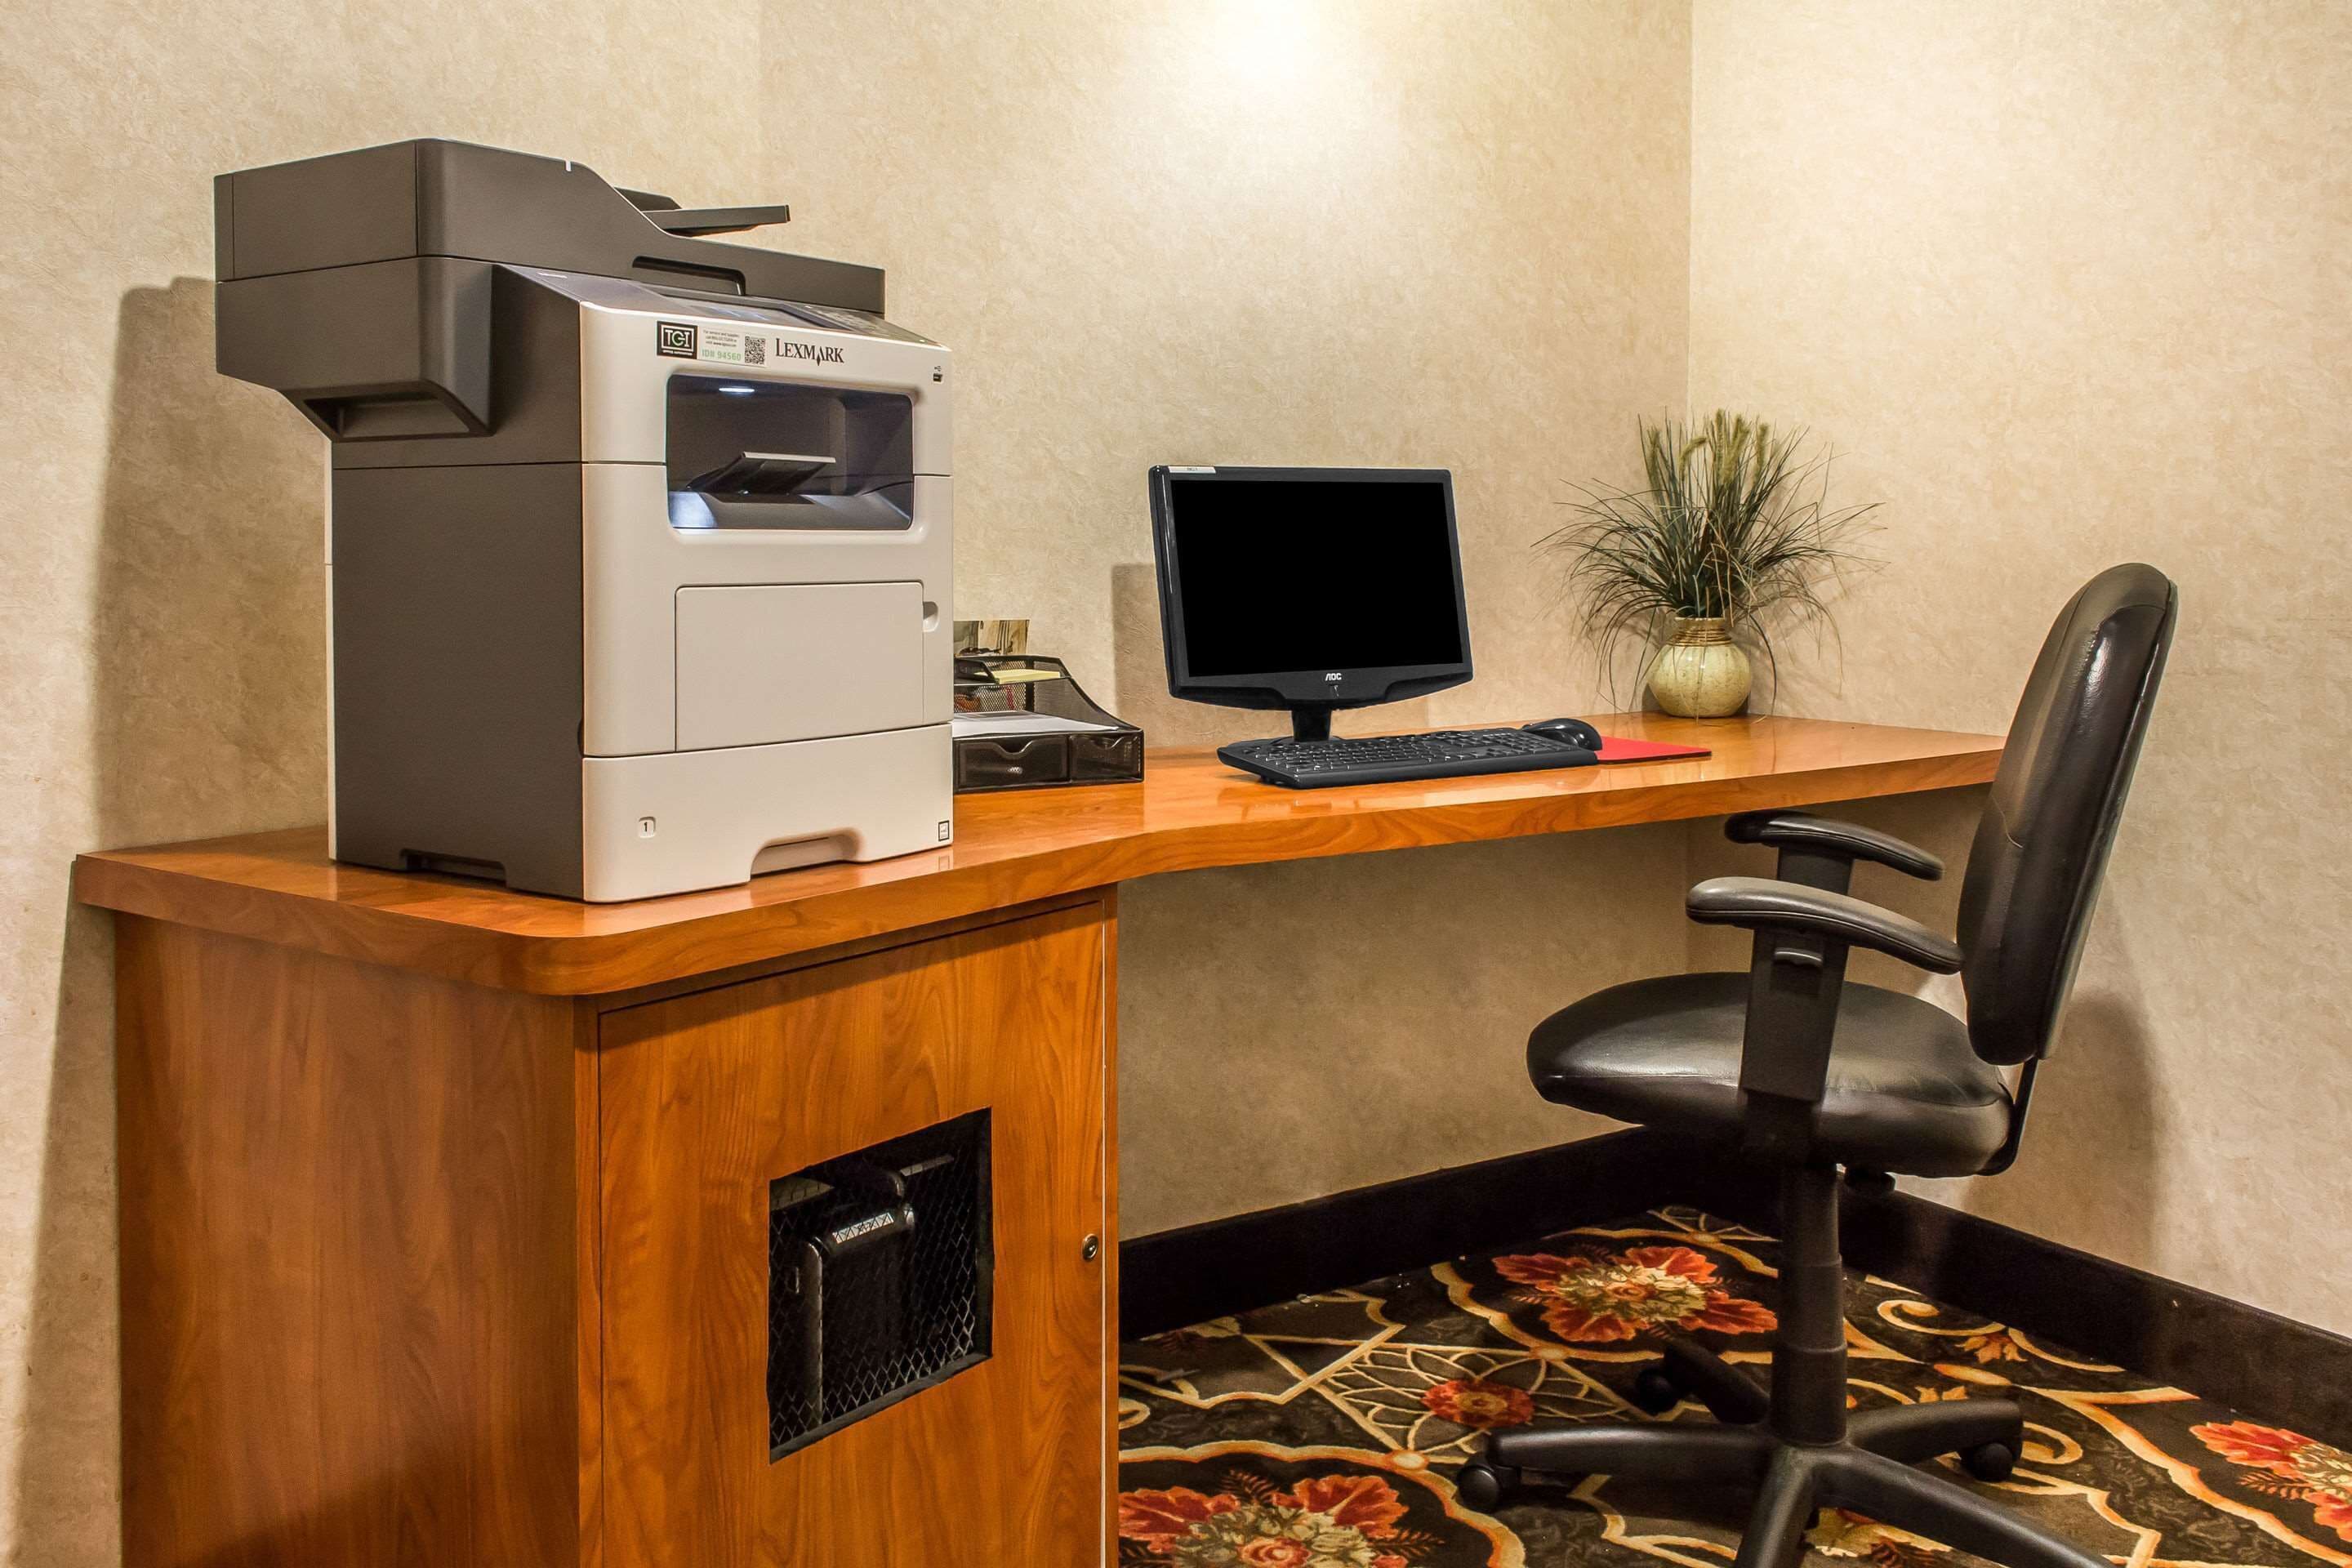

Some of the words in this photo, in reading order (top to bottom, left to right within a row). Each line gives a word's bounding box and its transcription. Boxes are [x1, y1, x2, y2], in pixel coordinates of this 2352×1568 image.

[665, 329, 690, 347] TGI
[776, 337, 844, 366] LEXMARK
[1325, 672, 1342, 681] AOC
